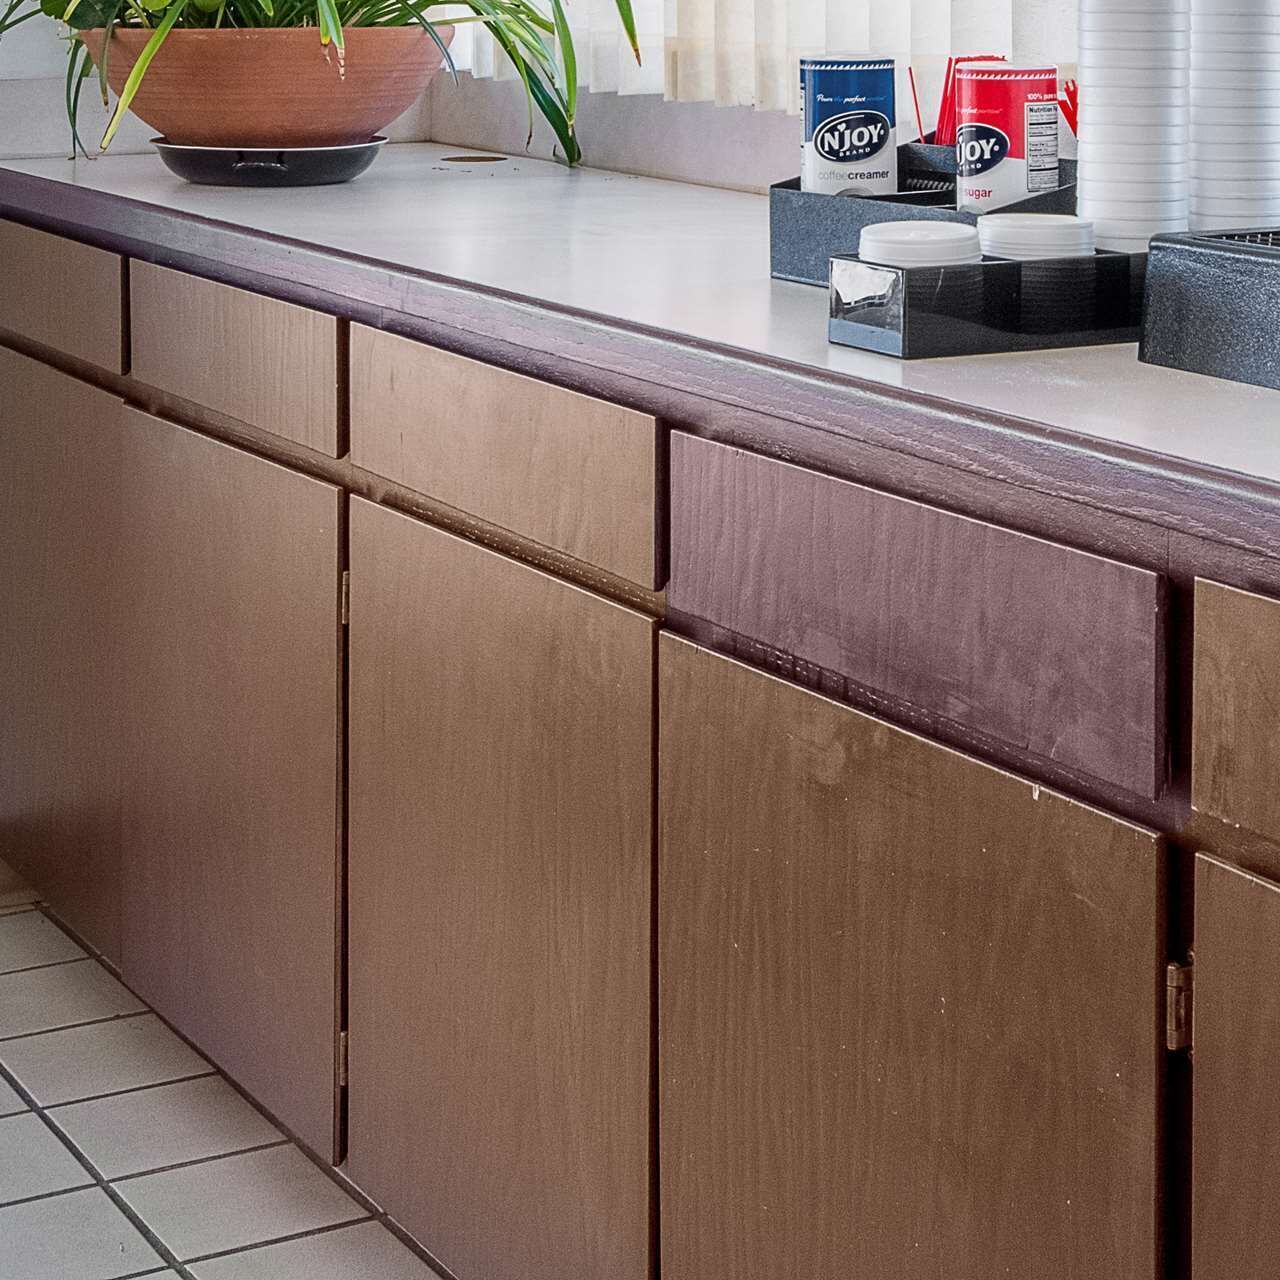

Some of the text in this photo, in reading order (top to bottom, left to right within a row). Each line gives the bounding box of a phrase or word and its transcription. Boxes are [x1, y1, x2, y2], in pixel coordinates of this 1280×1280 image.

[839, 147, 871, 157] BRAND
[848, 169, 890, 181] creamer
[964, 188, 992, 199] sugar
